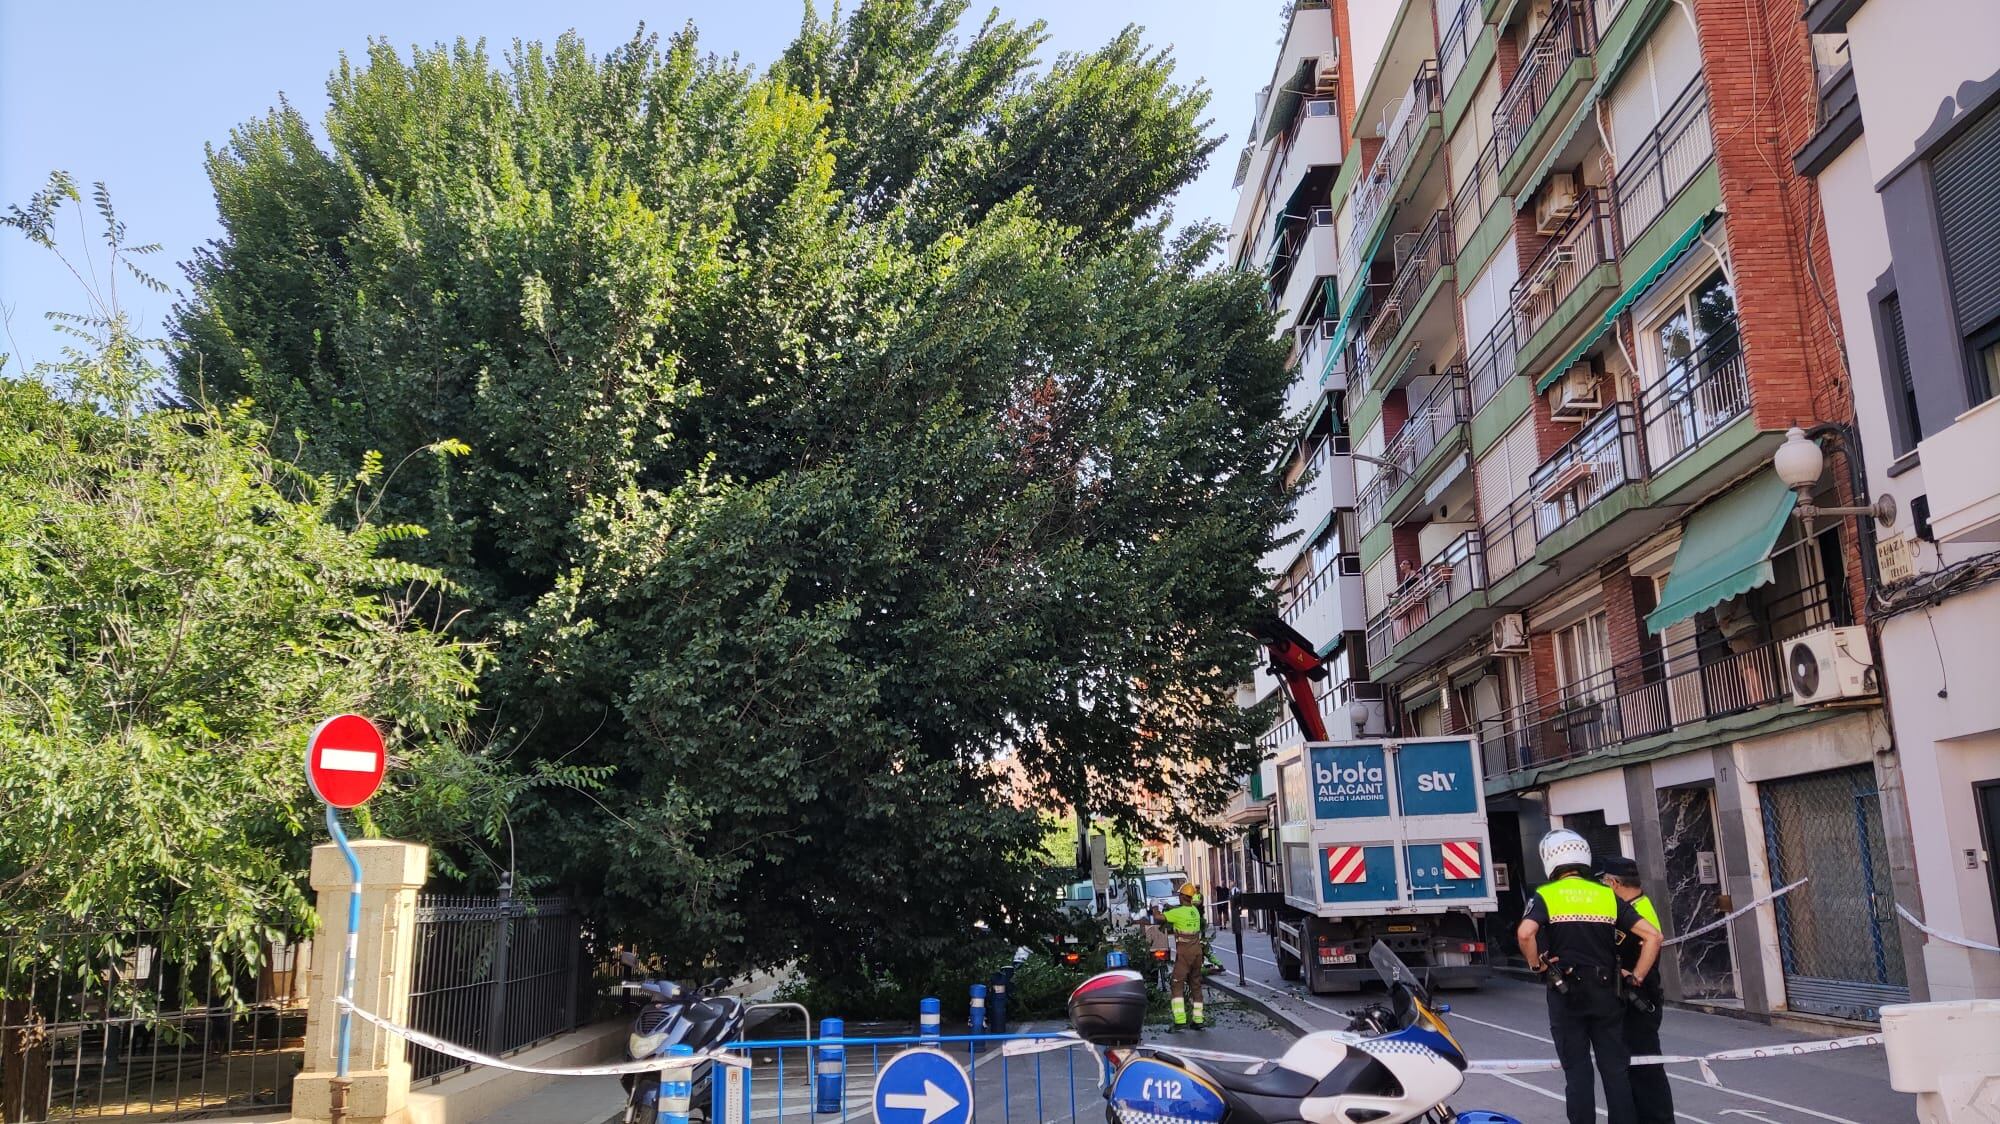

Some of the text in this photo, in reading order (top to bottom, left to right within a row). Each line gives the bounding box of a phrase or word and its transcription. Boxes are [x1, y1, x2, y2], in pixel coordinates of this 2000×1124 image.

[1879, 539, 1904, 557] PLAZA
[1316, 761, 1382, 784] brota
[1720, 768, 1727, 782] 17
[1155, 1080, 1182, 1099] 112
